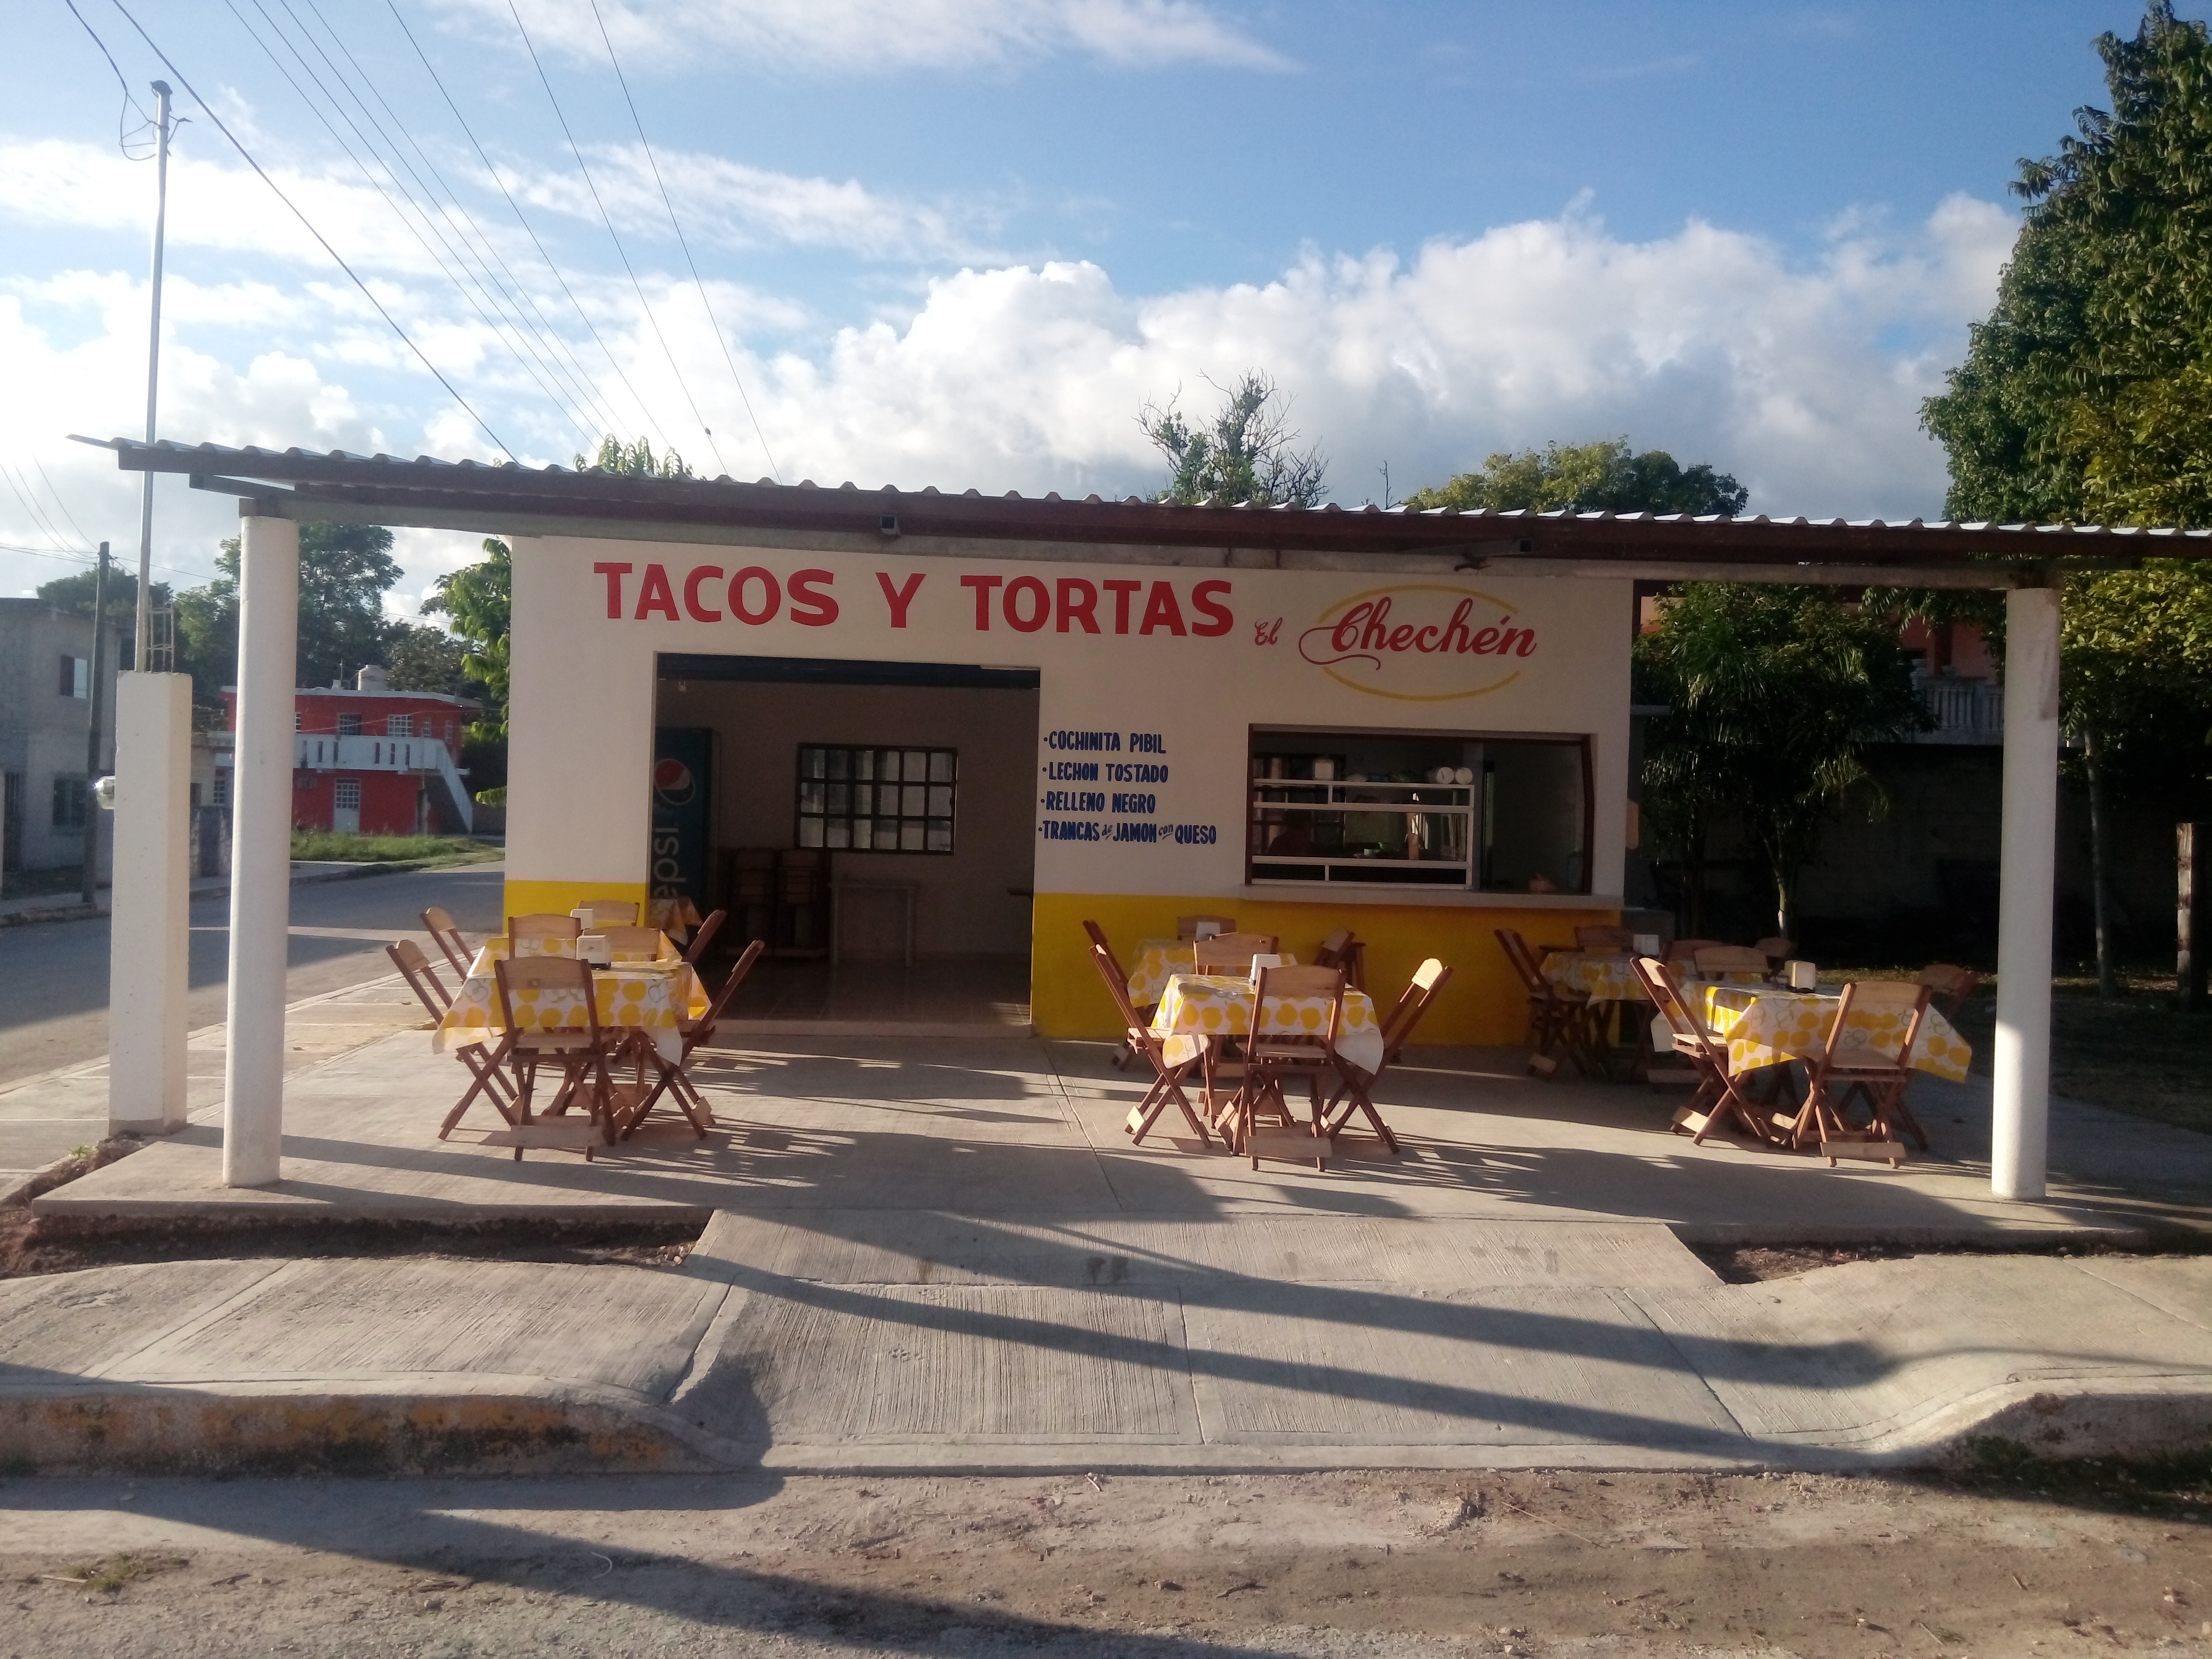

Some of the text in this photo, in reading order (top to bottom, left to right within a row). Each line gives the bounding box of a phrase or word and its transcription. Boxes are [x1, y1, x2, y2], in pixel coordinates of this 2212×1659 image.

[593, 562, 1234, 637] TACOS Y TORTAS
[1254, 596, 1537, 671] El Chechén
[1049, 730, 1167, 754] COCHINITA PIBIL
[1049, 761, 1169, 783] LECHON TOSTADO
[1046, 791, 1156, 814] RELLENO NEGRO
[1042, 820, 1217, 845] TRANCAS de JAMON con QUESO
